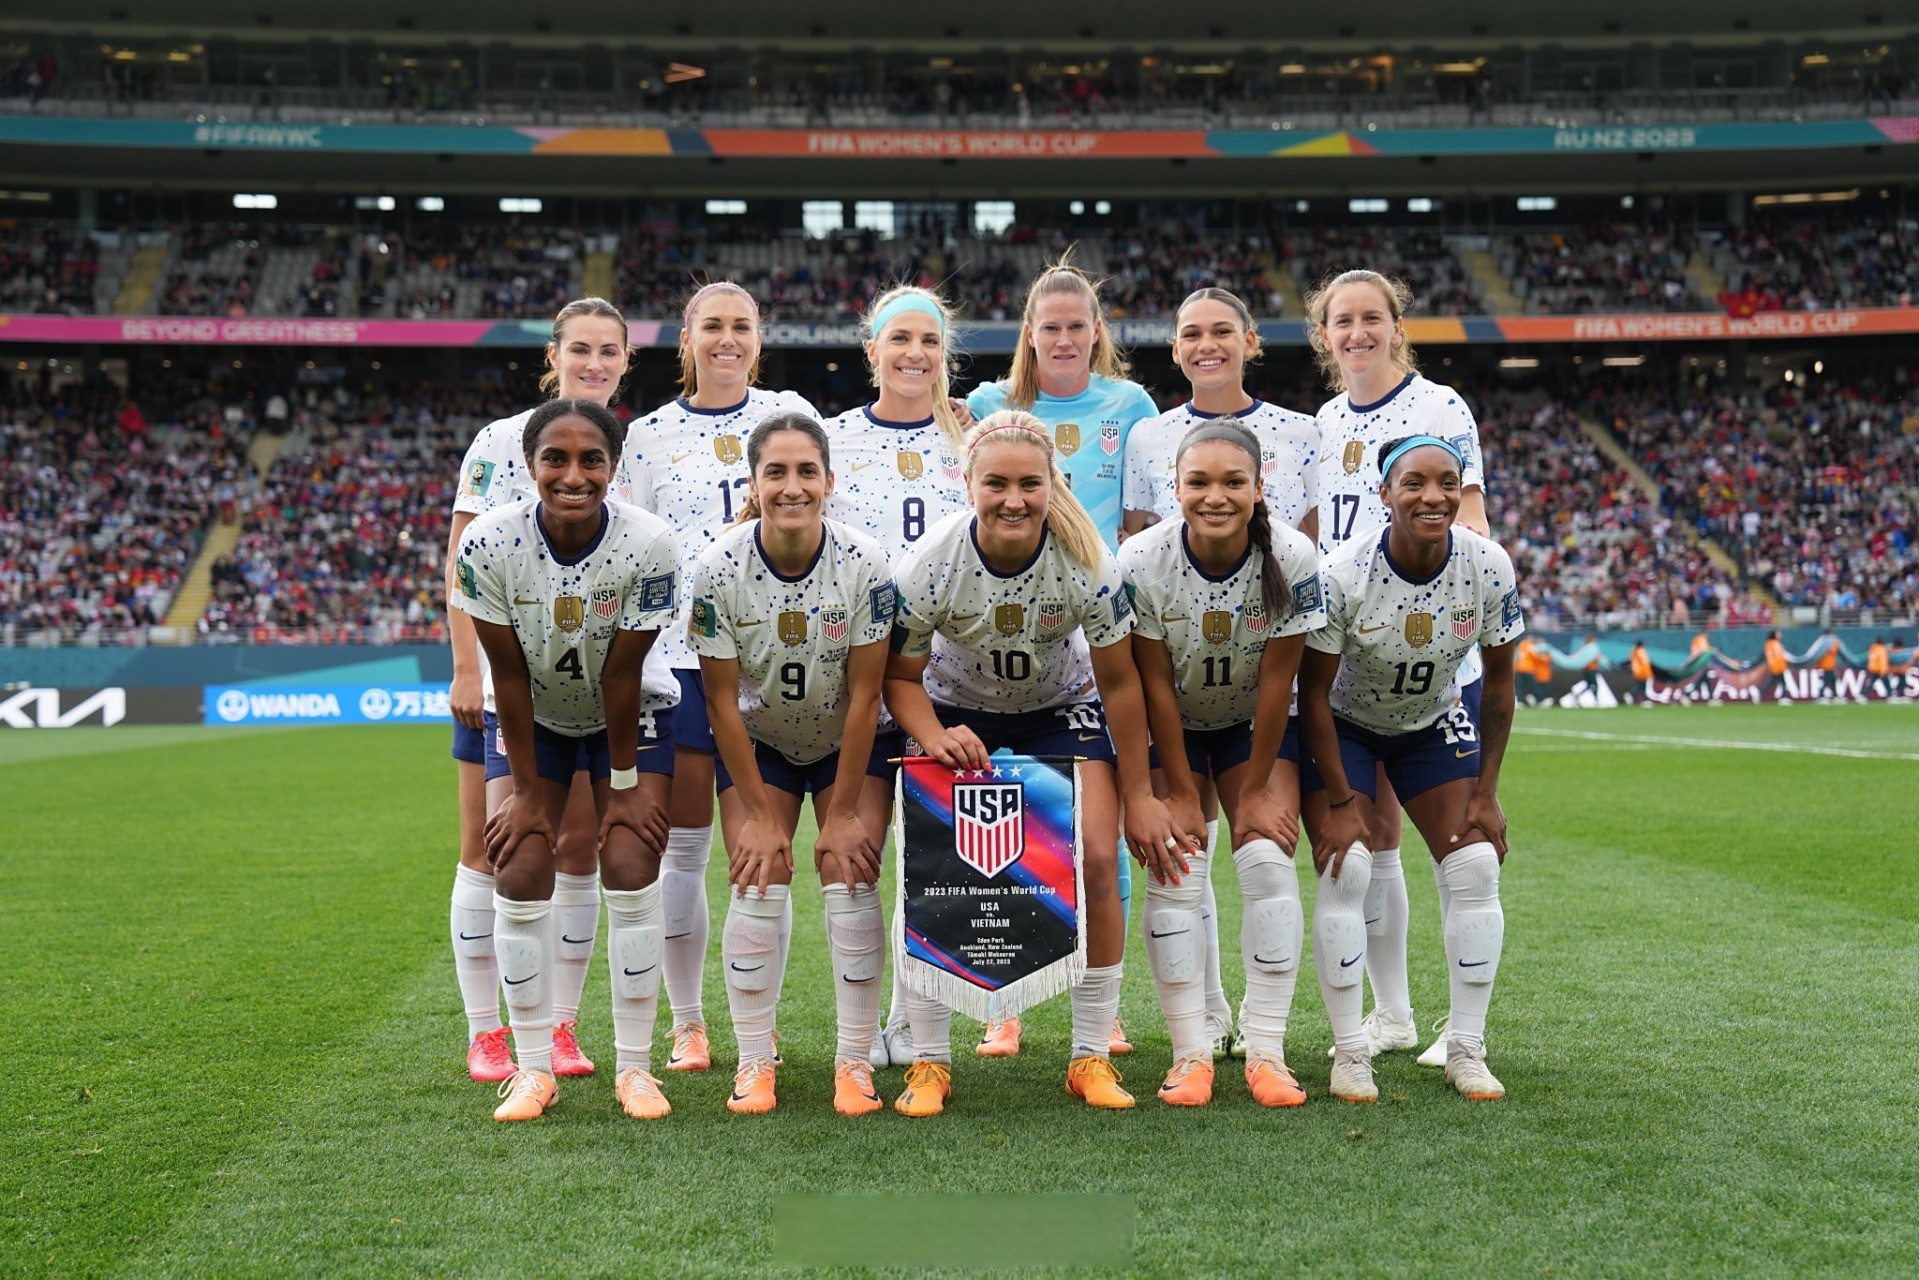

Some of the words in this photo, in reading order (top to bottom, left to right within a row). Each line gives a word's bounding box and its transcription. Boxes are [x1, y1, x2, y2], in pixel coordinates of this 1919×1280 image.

[809, 134, 854, 152] FIFA
[858, 134, 963, 153] WOMEN'S
[967, 135, 1047, 153] WORLD
[1051, 135, 1097, 153] CUP
[122, 321, 217, 341] BEYOND
[221, 321, 358, 343] GREATNESS
[762, 324, 865, 345] UCKLAND
[1574, 318, 1619, 338] FIFA
[1622, 316, 1723, 337] WOMEN'S
[1729, 315, 1805, 336] WORLD
[1811, 312, 1858, 333] CUP
[1101, 428, 1118, 439] USA
[941, 455, 959, 467] USA
[1262, 451, 1275, 462] SA
[902, 497, 925, 542] 8
[1331, 494, 1360, 541] 17
[593, 589, 616, 602] USA
[823, 611, 845, 624] USA
[1041, 604, 1064, 616] USA
[1453, 609, 1474, 623] USA
[555, 647, 584, 680] 4
[989, 649, 1031, 681] 10
[1201, 656, 1233, 687] 11
[781, 662, 806, 701] 9
[1390, 661, 1435, 695] 19
[251, 694, 341, 718] WANDA
[1055, 704, 1101, 729] 10
[958, 788, 1018, 825] USA
[924, 887, 946, 896] 2023
[948, 886, 966, 896] FIFA
[969, 886, 1008, 896] Women's
[1011, 885, 1037, 895] World
[1039, 885, 1056, 896] Cup
[980, 902, 999, 911] USA
[971, 918, 1010, 928] VIETNAM
